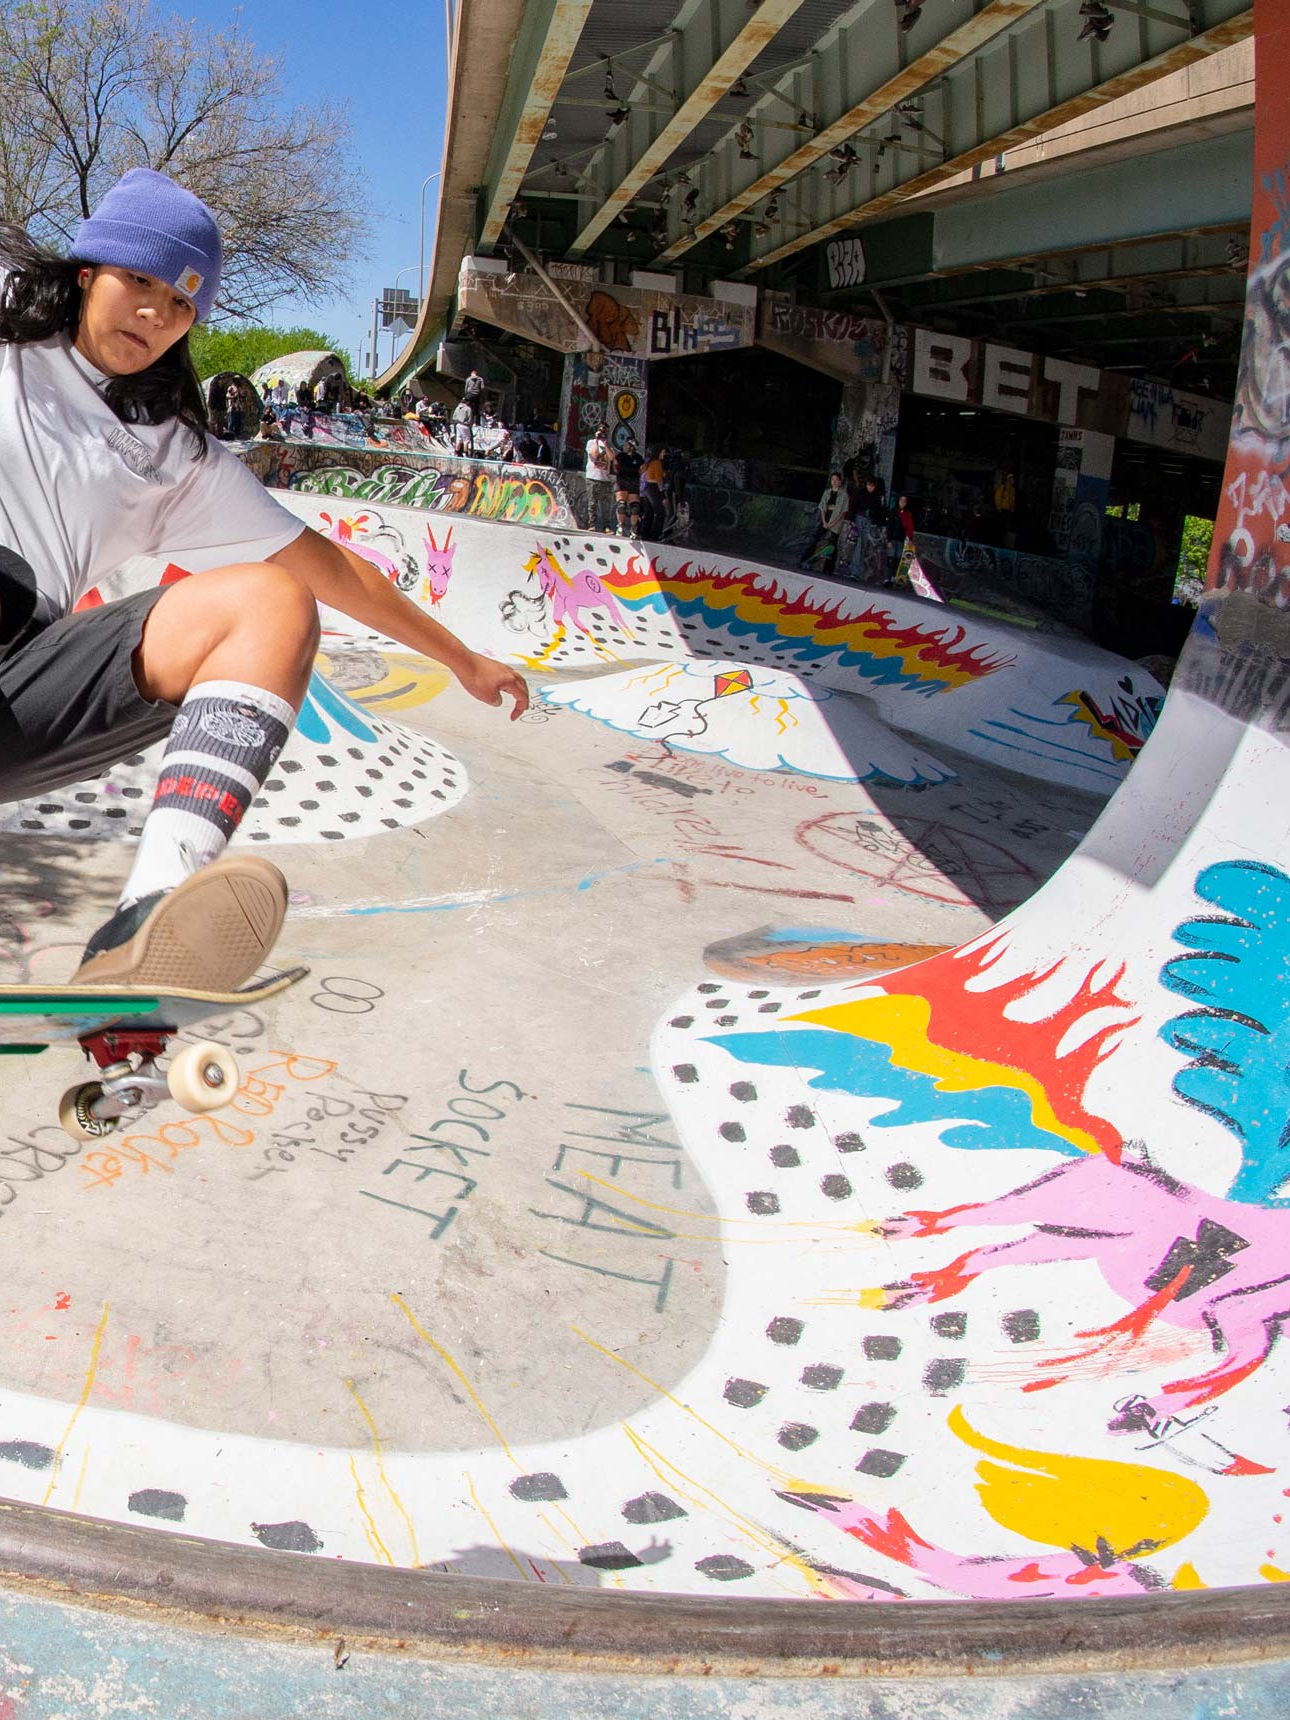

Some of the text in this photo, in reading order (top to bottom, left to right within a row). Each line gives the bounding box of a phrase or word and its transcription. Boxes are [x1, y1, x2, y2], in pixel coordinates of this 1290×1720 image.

[913, 328, 1103, 427] BET
[359, 1069, 524, 1241] SOCKET
[527, 1101, 683, 1315] MEAT
